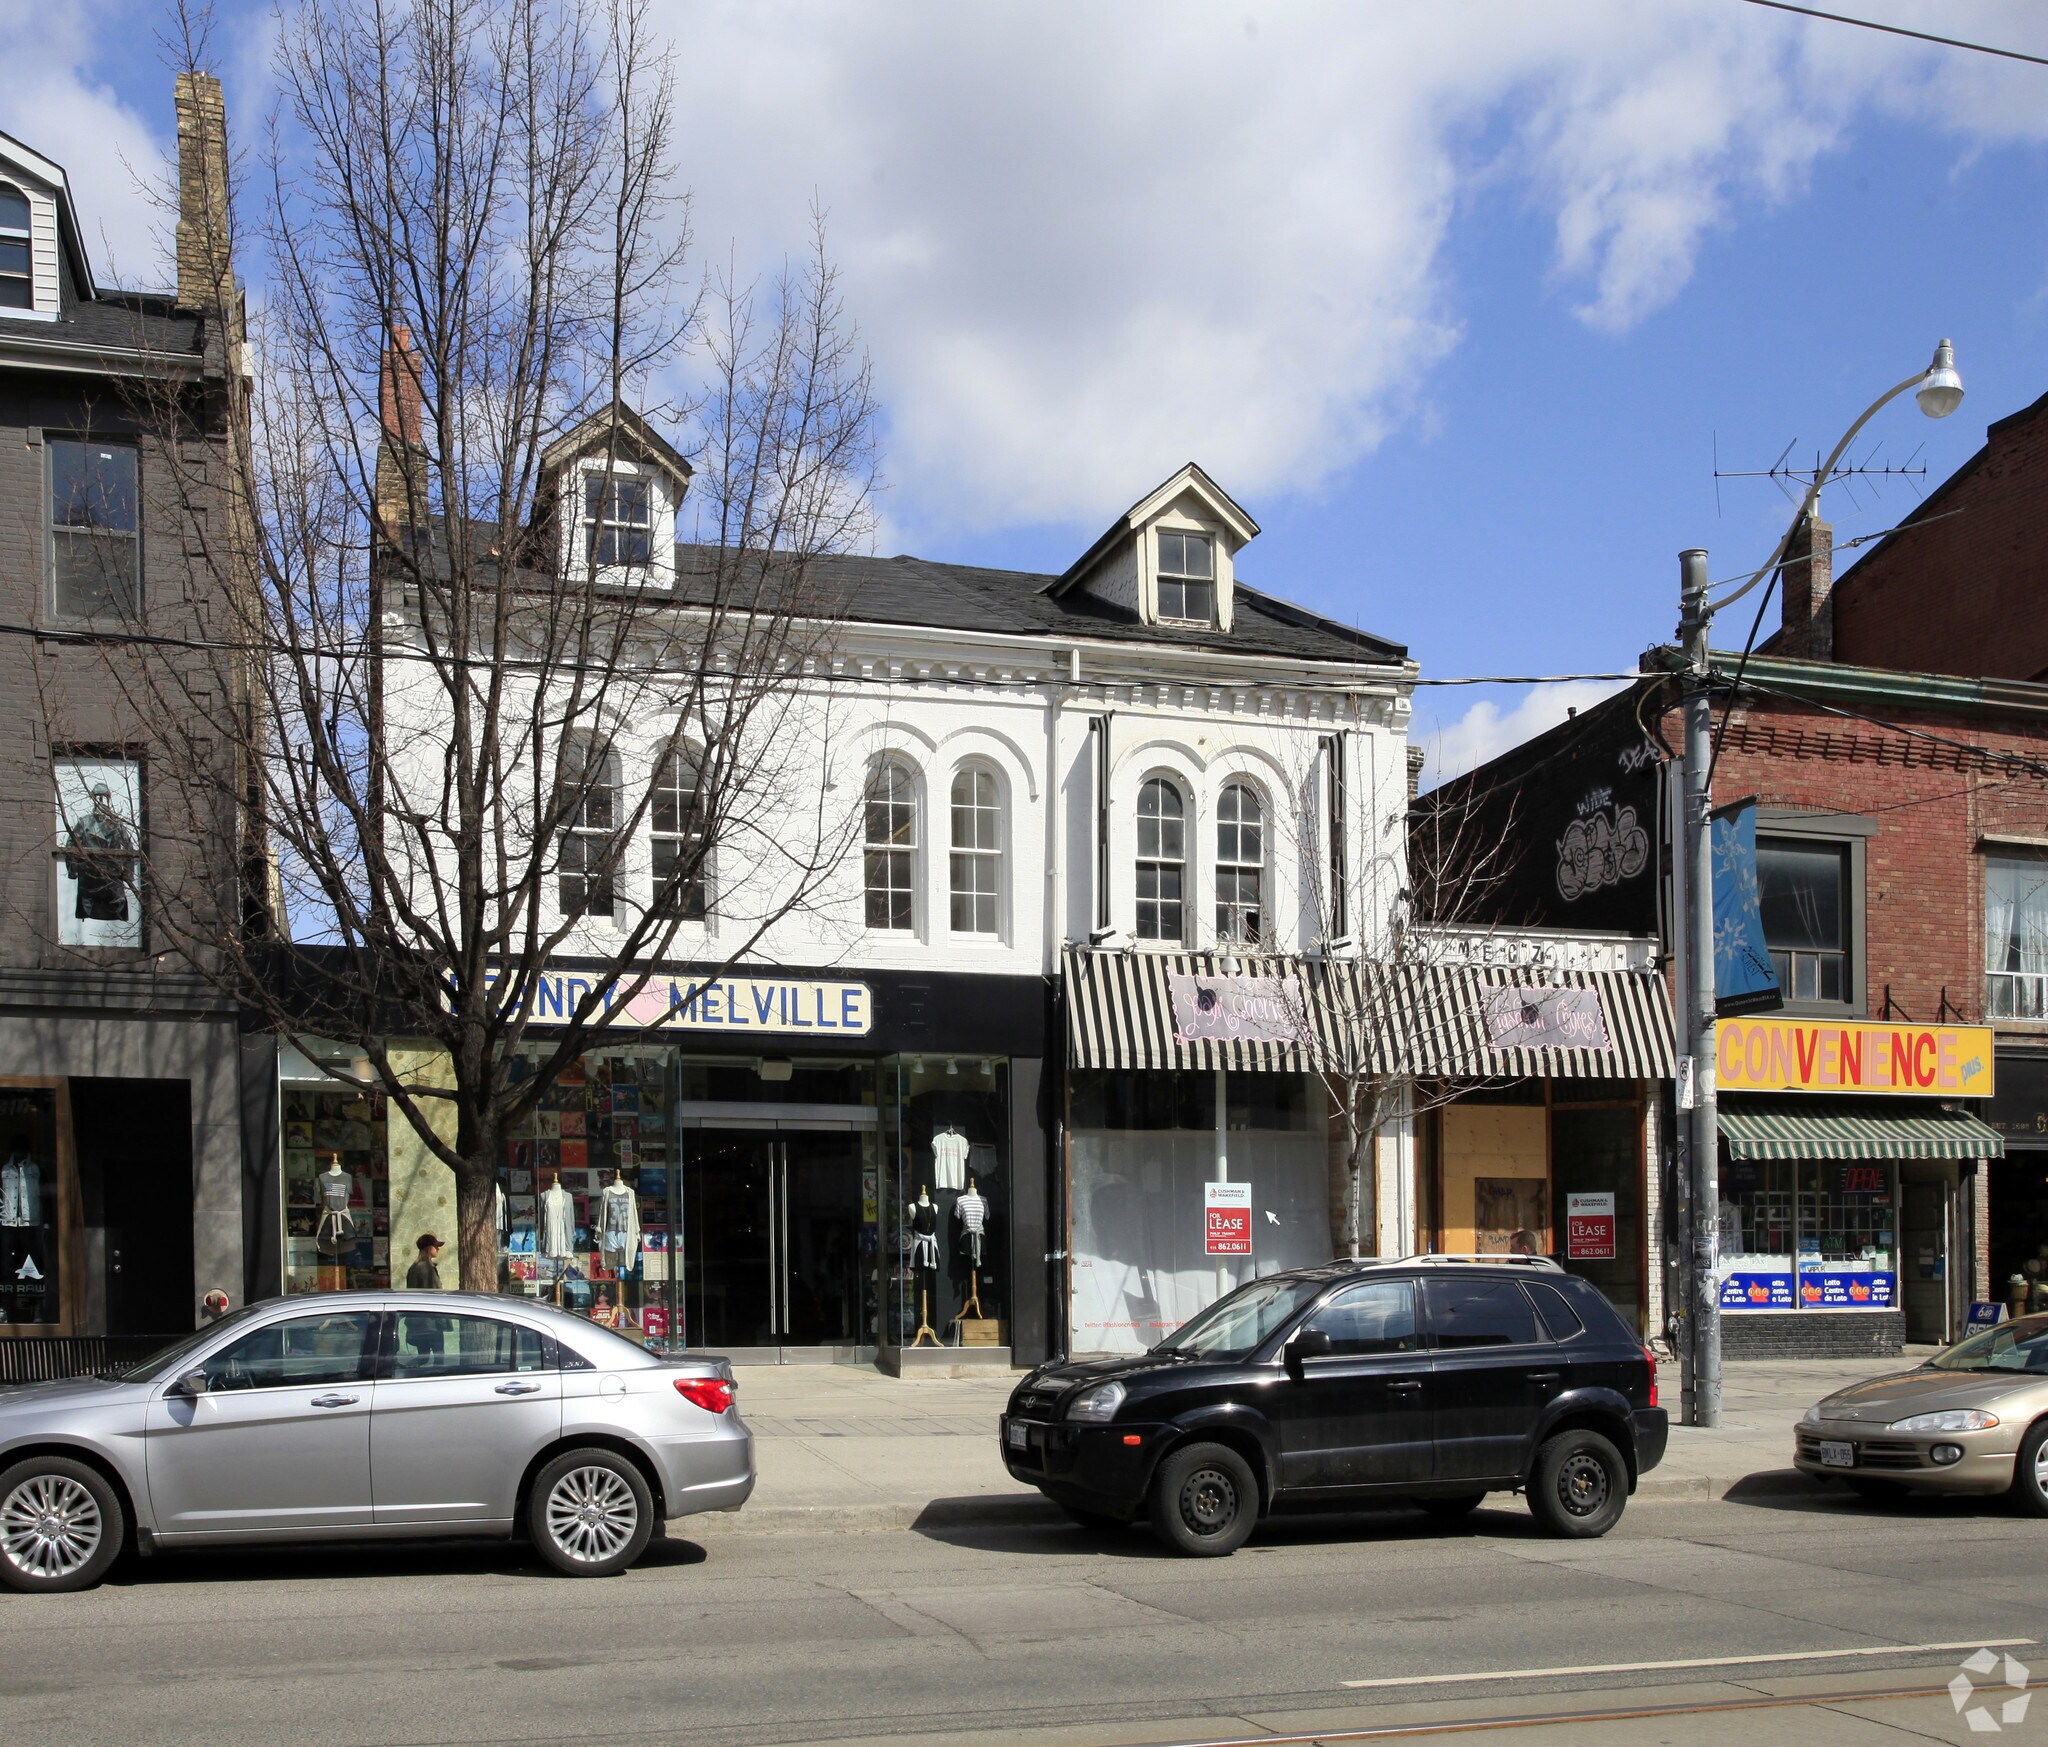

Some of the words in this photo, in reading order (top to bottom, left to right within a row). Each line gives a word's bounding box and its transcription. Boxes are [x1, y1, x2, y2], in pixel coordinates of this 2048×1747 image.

[450, 974, 619, 1018] ANDY
[669, 982, 863, 1028] MELVILLE
[1719, 1023, 1957, 1088] CONVENIENCE
[1846, 1167, 1880, 1191] OPEN
[1209, 1218, 1244, 1230] LEASE
[1571, 1225, 1607, 1236] LEASE
[1217, 1242, 1247, 1251] 862.0611
[1822, 1235, 1843, 1249] ATM
[1580, 1247, 1610, 1255] 862.0611
[1824, 1278, 1841, 1286] Lotto
[16, 1284, 46, 1293] RAW
[1771, 1287, 1790, 1295] entre
